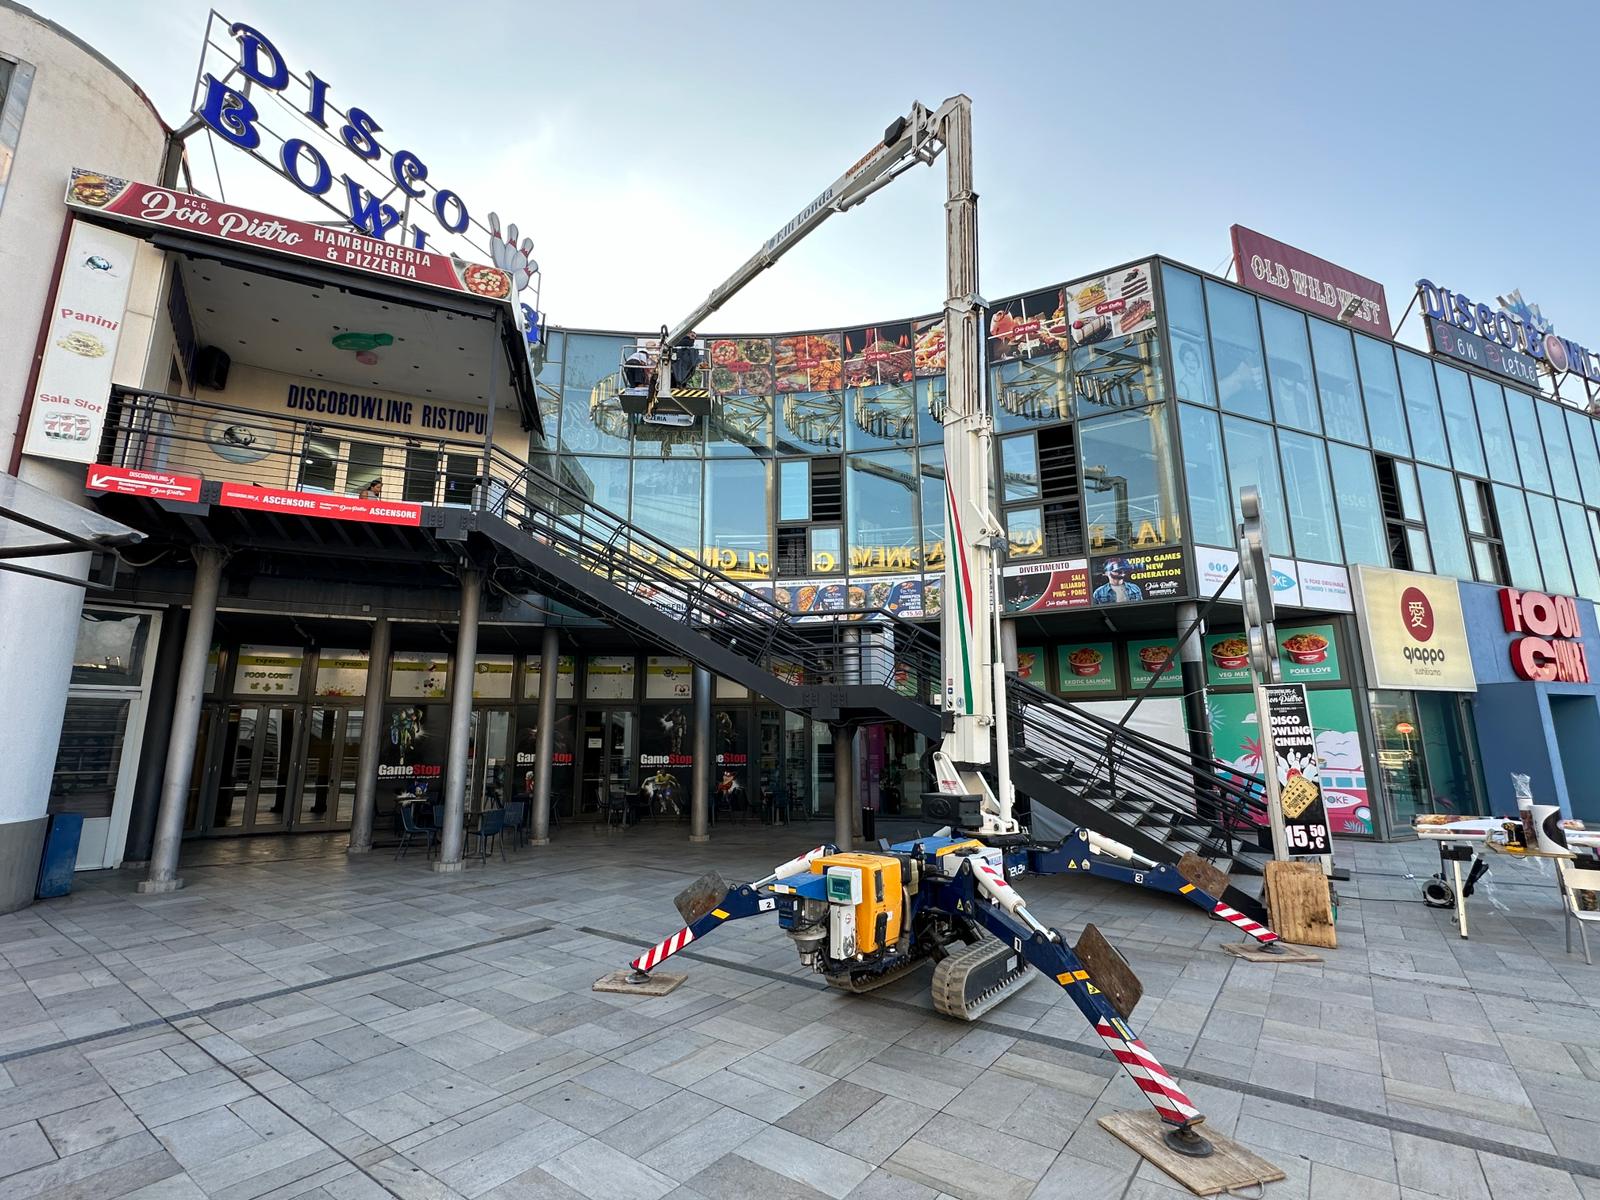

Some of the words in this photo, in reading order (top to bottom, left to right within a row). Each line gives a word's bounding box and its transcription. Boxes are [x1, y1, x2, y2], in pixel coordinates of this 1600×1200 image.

[228, 22, 469, 234] DISCO
[141, 191, 211, 225] Don
[218, 212, 303, 246] Pietro
[314, 229, 431, 267] HAMBURGERIA
[327, 248, 338, 260] &
[346, 251, 416, 278] PIZZERIA
[1251, 254, 1290, 289] OLD
[1290, 268, 1338, 308] WILD
[61, 308, 120, 331] Panini
[40, 394, 70, 405] Sala
[74, 398, 102, 414] Slot
[287, 384, 412, 425] DISCOBOWLING
[263, 495, 315, 508] ASCENSORE
[369, 508, 416, 518] ASCENSORE
[1126, 556, 1152, 565] VIDEO
[1154, 552, 1182, 562] GAMES
[1020, 562, 1070, 574] DIVERTIMENTO
[1146, 562, 1164, 570] NEW
[1130, 568, 1181, 580] GENERATION
[1408, 602, 1428, 628] 愛
[1498, 588, 1582, 639] FOOD
[1271, 715, 1300, 725] DISCO
[1272, 726, 1310, 736] OWLING
[1274, 736, 1312, 746] CINEMA
[640, 753, 693, 764] GameStop
[378, 764, 441, 776] GameStop
